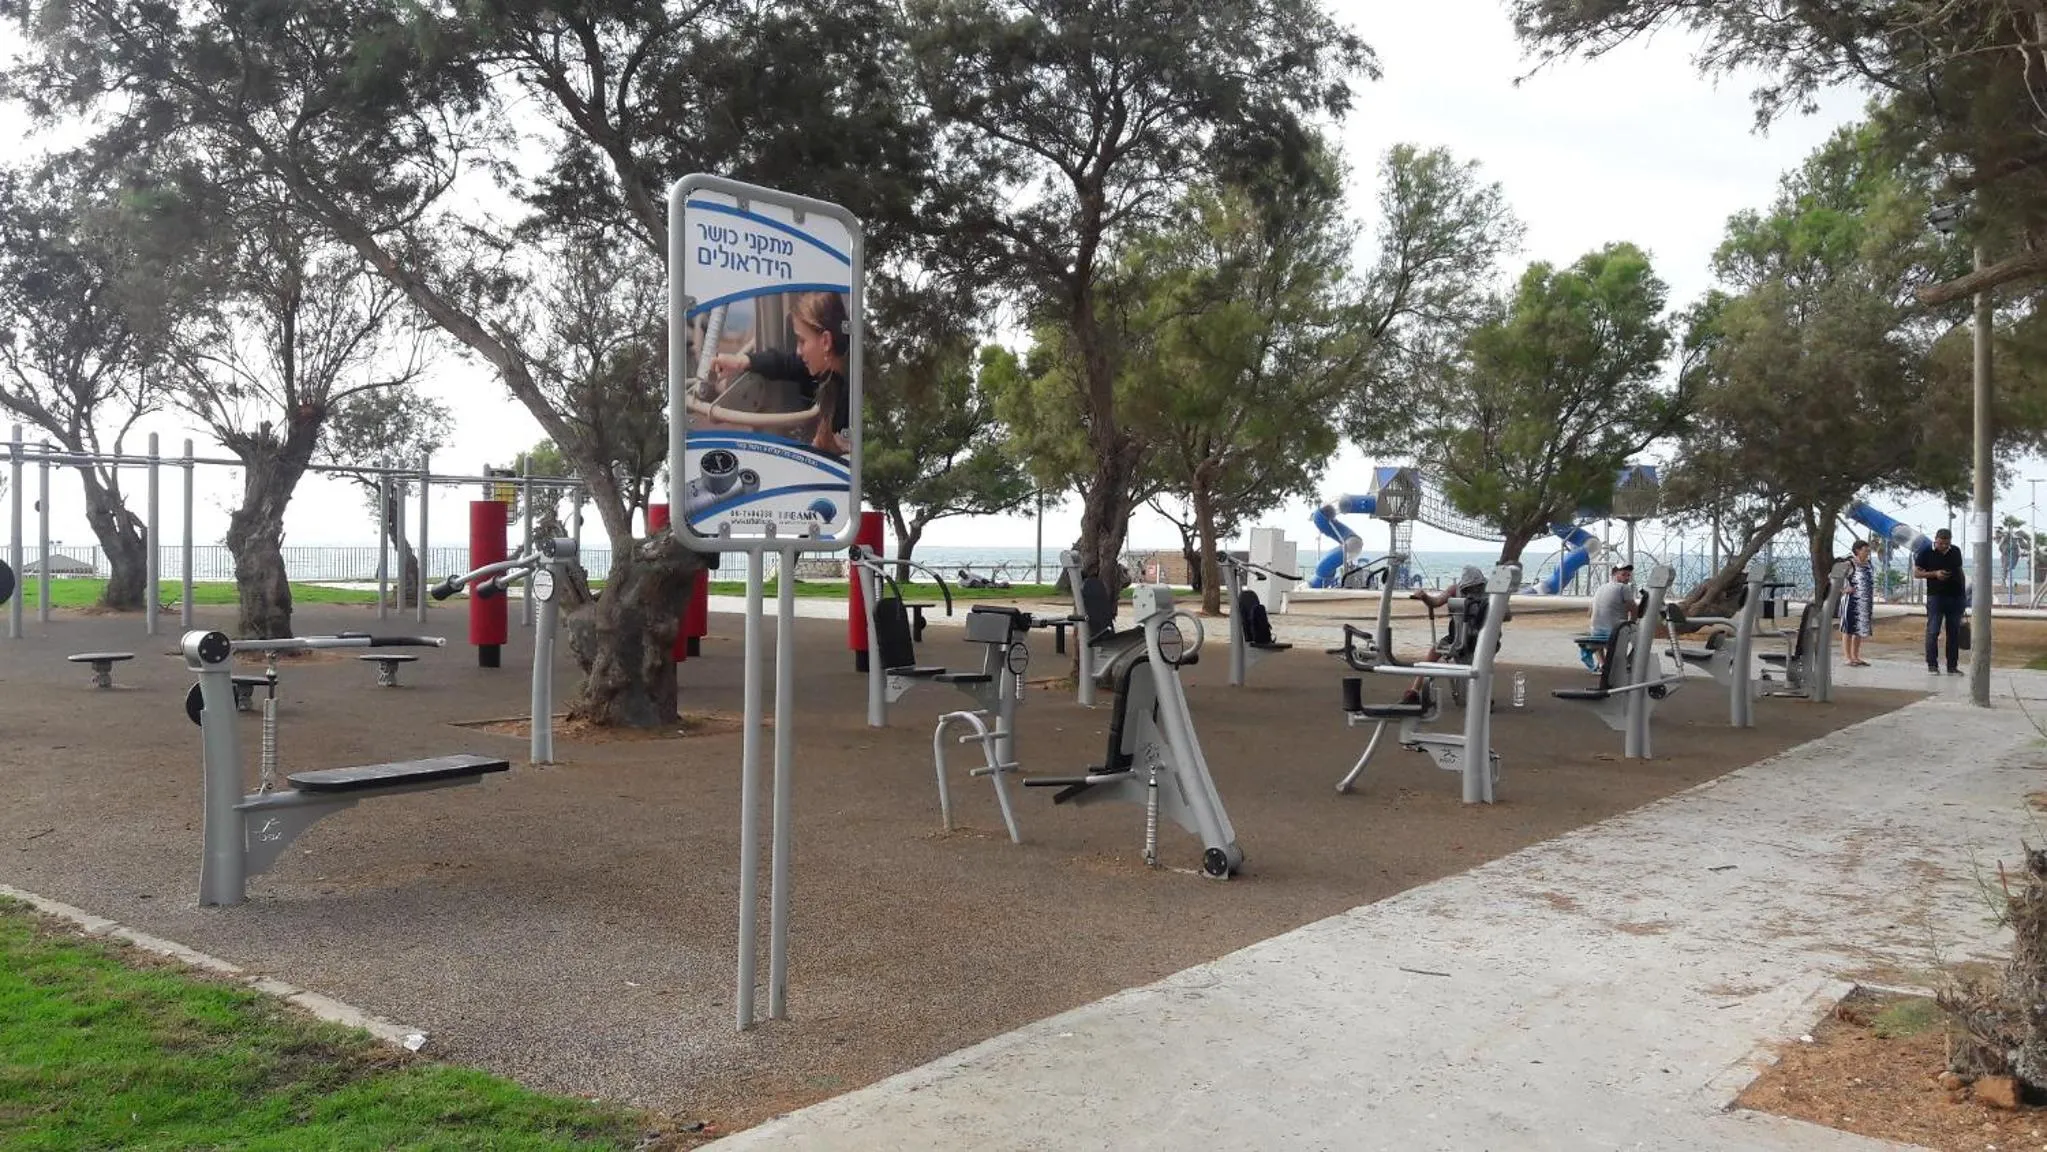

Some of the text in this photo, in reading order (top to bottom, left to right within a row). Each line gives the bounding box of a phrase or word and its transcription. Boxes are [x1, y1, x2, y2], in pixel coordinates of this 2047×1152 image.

[697, 223, 794, 256] מתקני כושר
[698, 245, 793, 280] הידראולים
